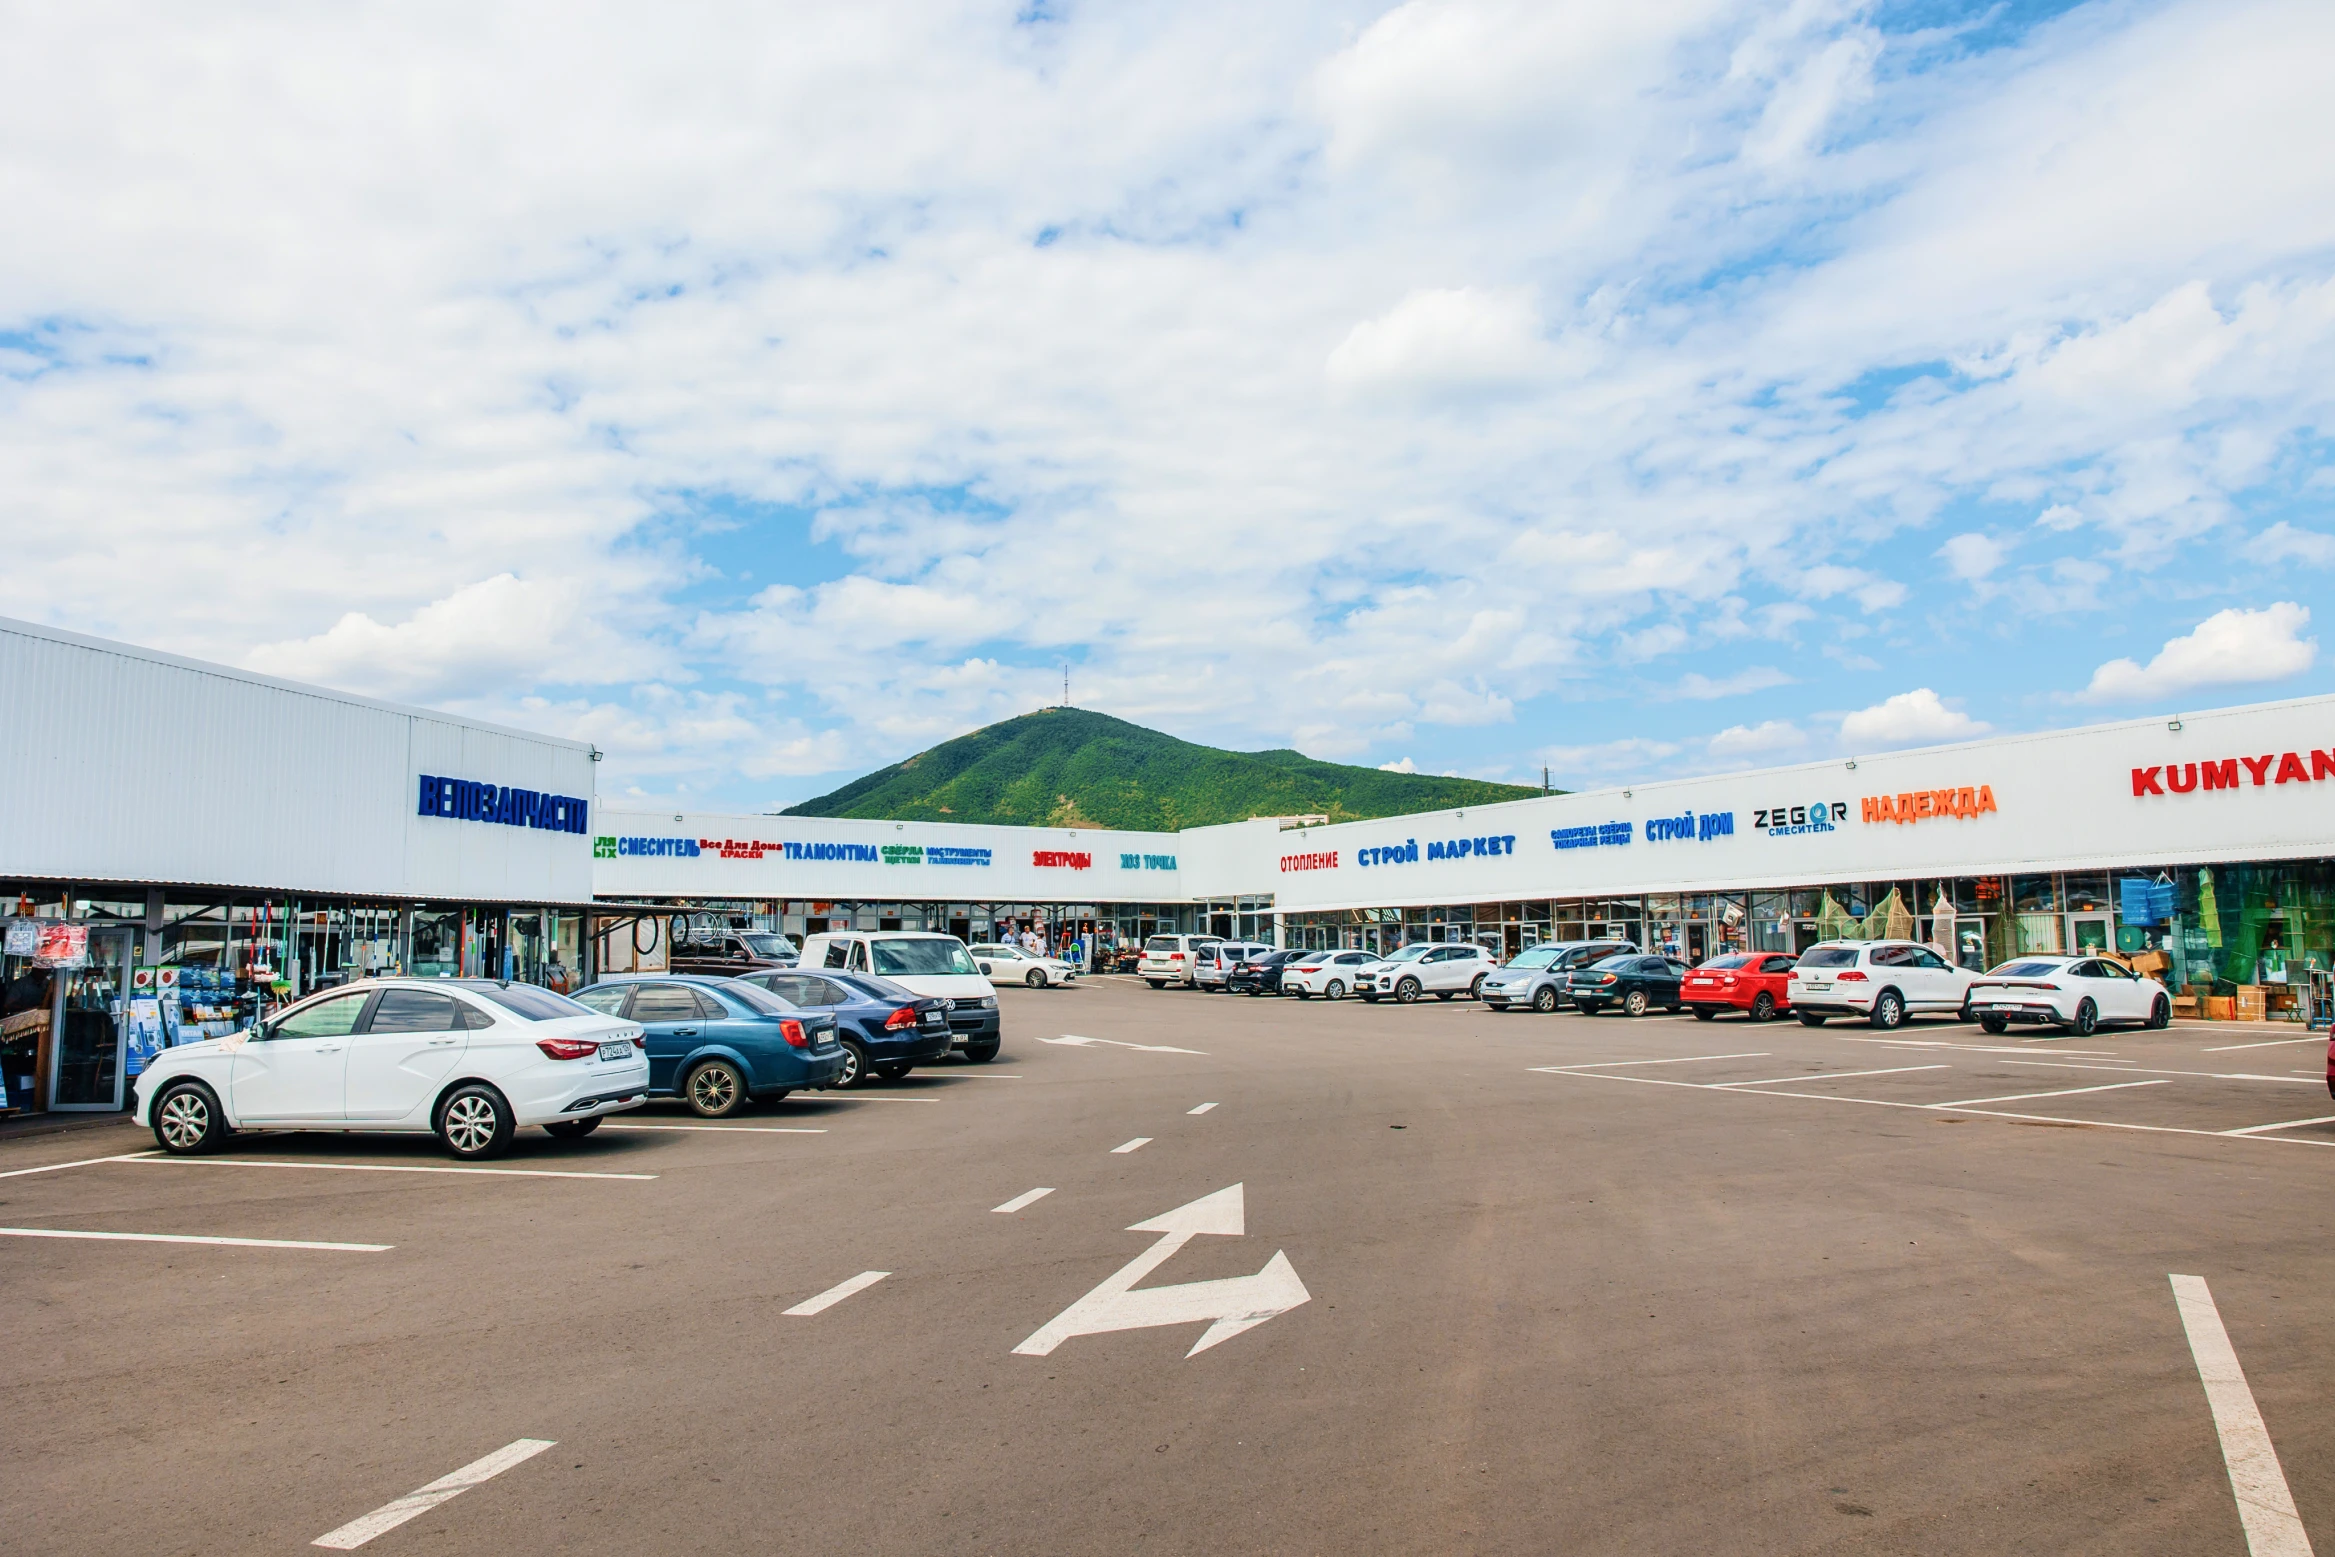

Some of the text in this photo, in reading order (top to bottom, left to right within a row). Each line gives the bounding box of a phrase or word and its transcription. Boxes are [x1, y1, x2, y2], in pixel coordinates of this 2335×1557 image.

[2131, 747, 2335, 797] KUMYAN
[418, 774, 588, 834] ВЕЛОЗАПЧАСТИ
[1861, 785, 1997, 825] НАДЕЖДА
[1753, 802, 1847, 828] ZEGOR
[1550, 826, 1598, 841] САМОРЕЗЫ
[1646, 811, 1734, 841] СТРОЙ ДОМ
[1768, 822, 1835, 837] СМЕСИТЕЛЬ
[618, 836, 700, 857] СМЕСИТЕЛЬ
[700, 839, 783, 851] Все Для Дома
[1357, 835, 1516, 866] СТРОЙ МАРКЕТ
[1552, 833, 1631, 849] ТОКАРНЫЕ РЕЗЦЫ
[720, 849, 763, 858] КРАСКИ
[783, 842, 878, 862] TRAMONTINA
[1033, 851, 1091, 870] ЭЛЕКТРОДЫ
[1120, 854, 1177, 870] ХОЗ ТОЧКА
[1280, 851, 1338, 872] ОТОПЛЕНИЕ
